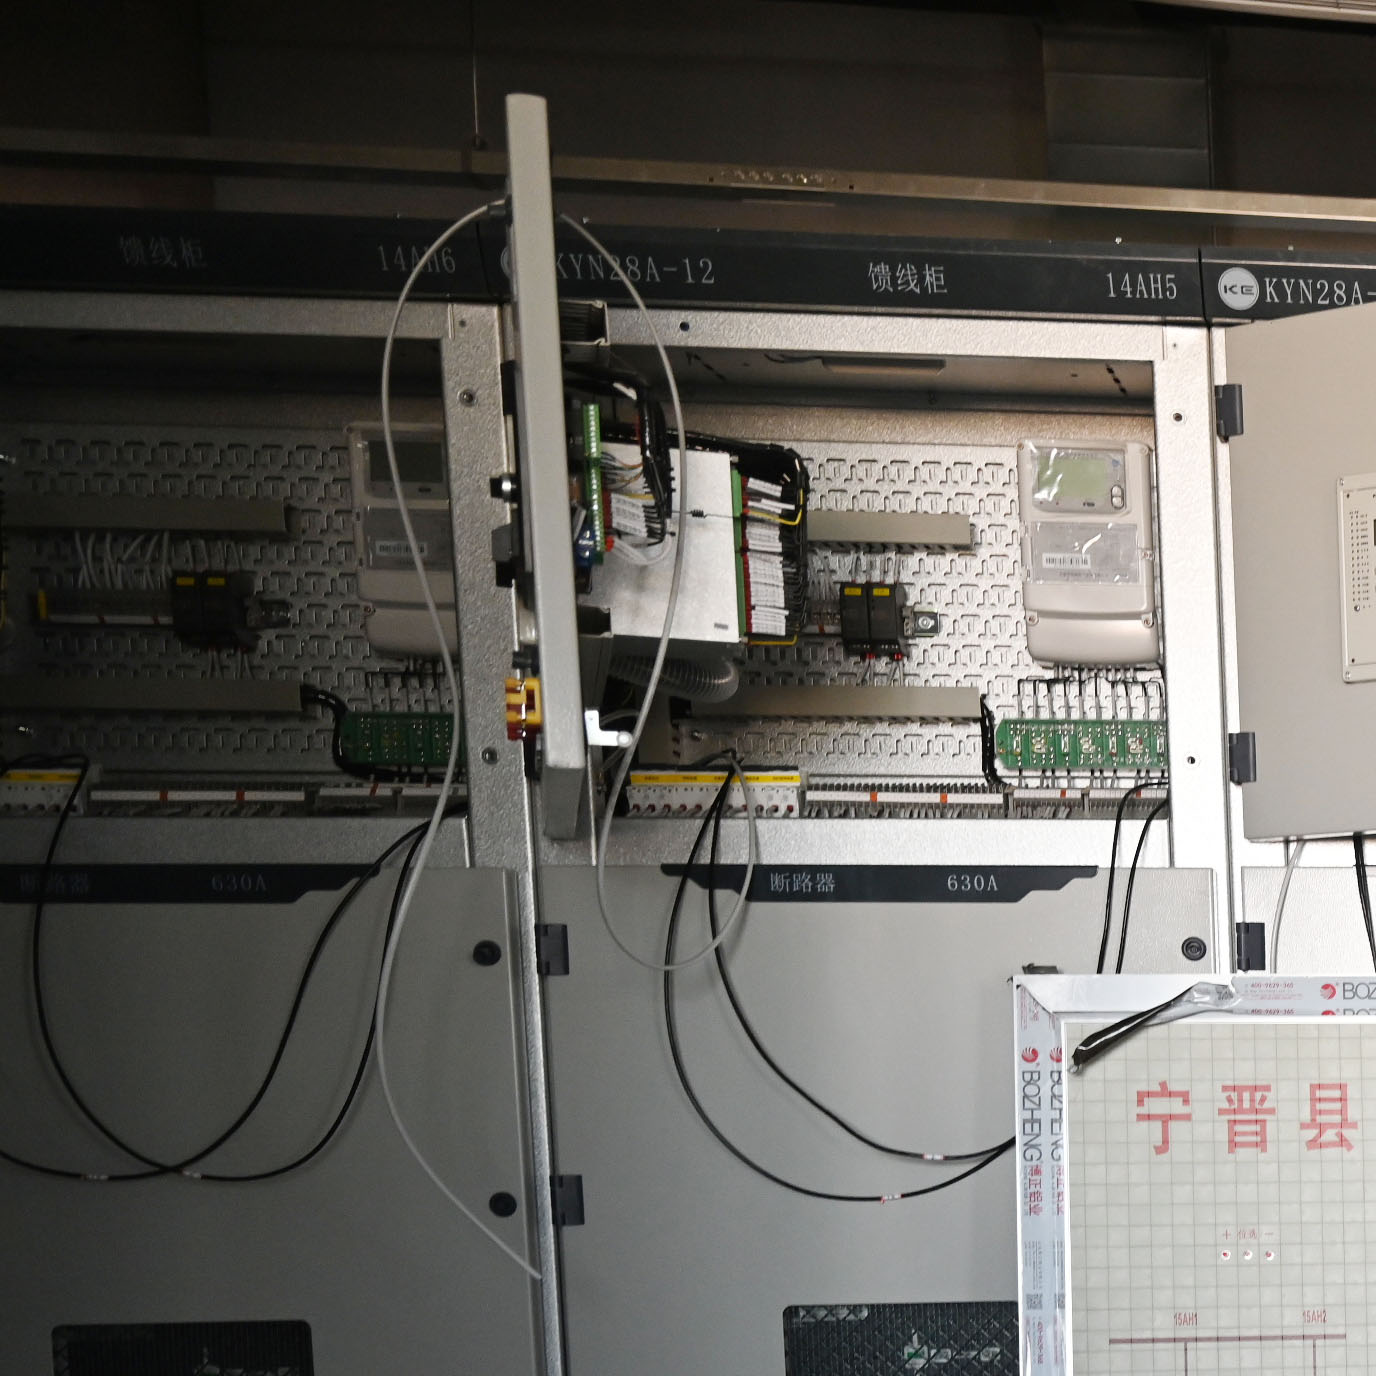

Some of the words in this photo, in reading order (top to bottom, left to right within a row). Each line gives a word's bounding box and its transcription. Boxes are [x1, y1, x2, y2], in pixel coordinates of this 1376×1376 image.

[556, 253, 715, 284] KYN28A-12
[868, 262, 948, 294] 馈线柜
[1106, 273, 1178, 299] 14AH5
[211, 873, 268, 892] 630A
[769, 872, 836, 893] 断路器
[947, 874, 998, 892] 630A
[1022, 1070, 1043, 1162] BOZHENG
[1028, 1165, 1043, 1216] 博正铝业
[1174, 1312, 1198, 1326] 15AH1
[1303, 1310, 1327, 1323] 15AH2
